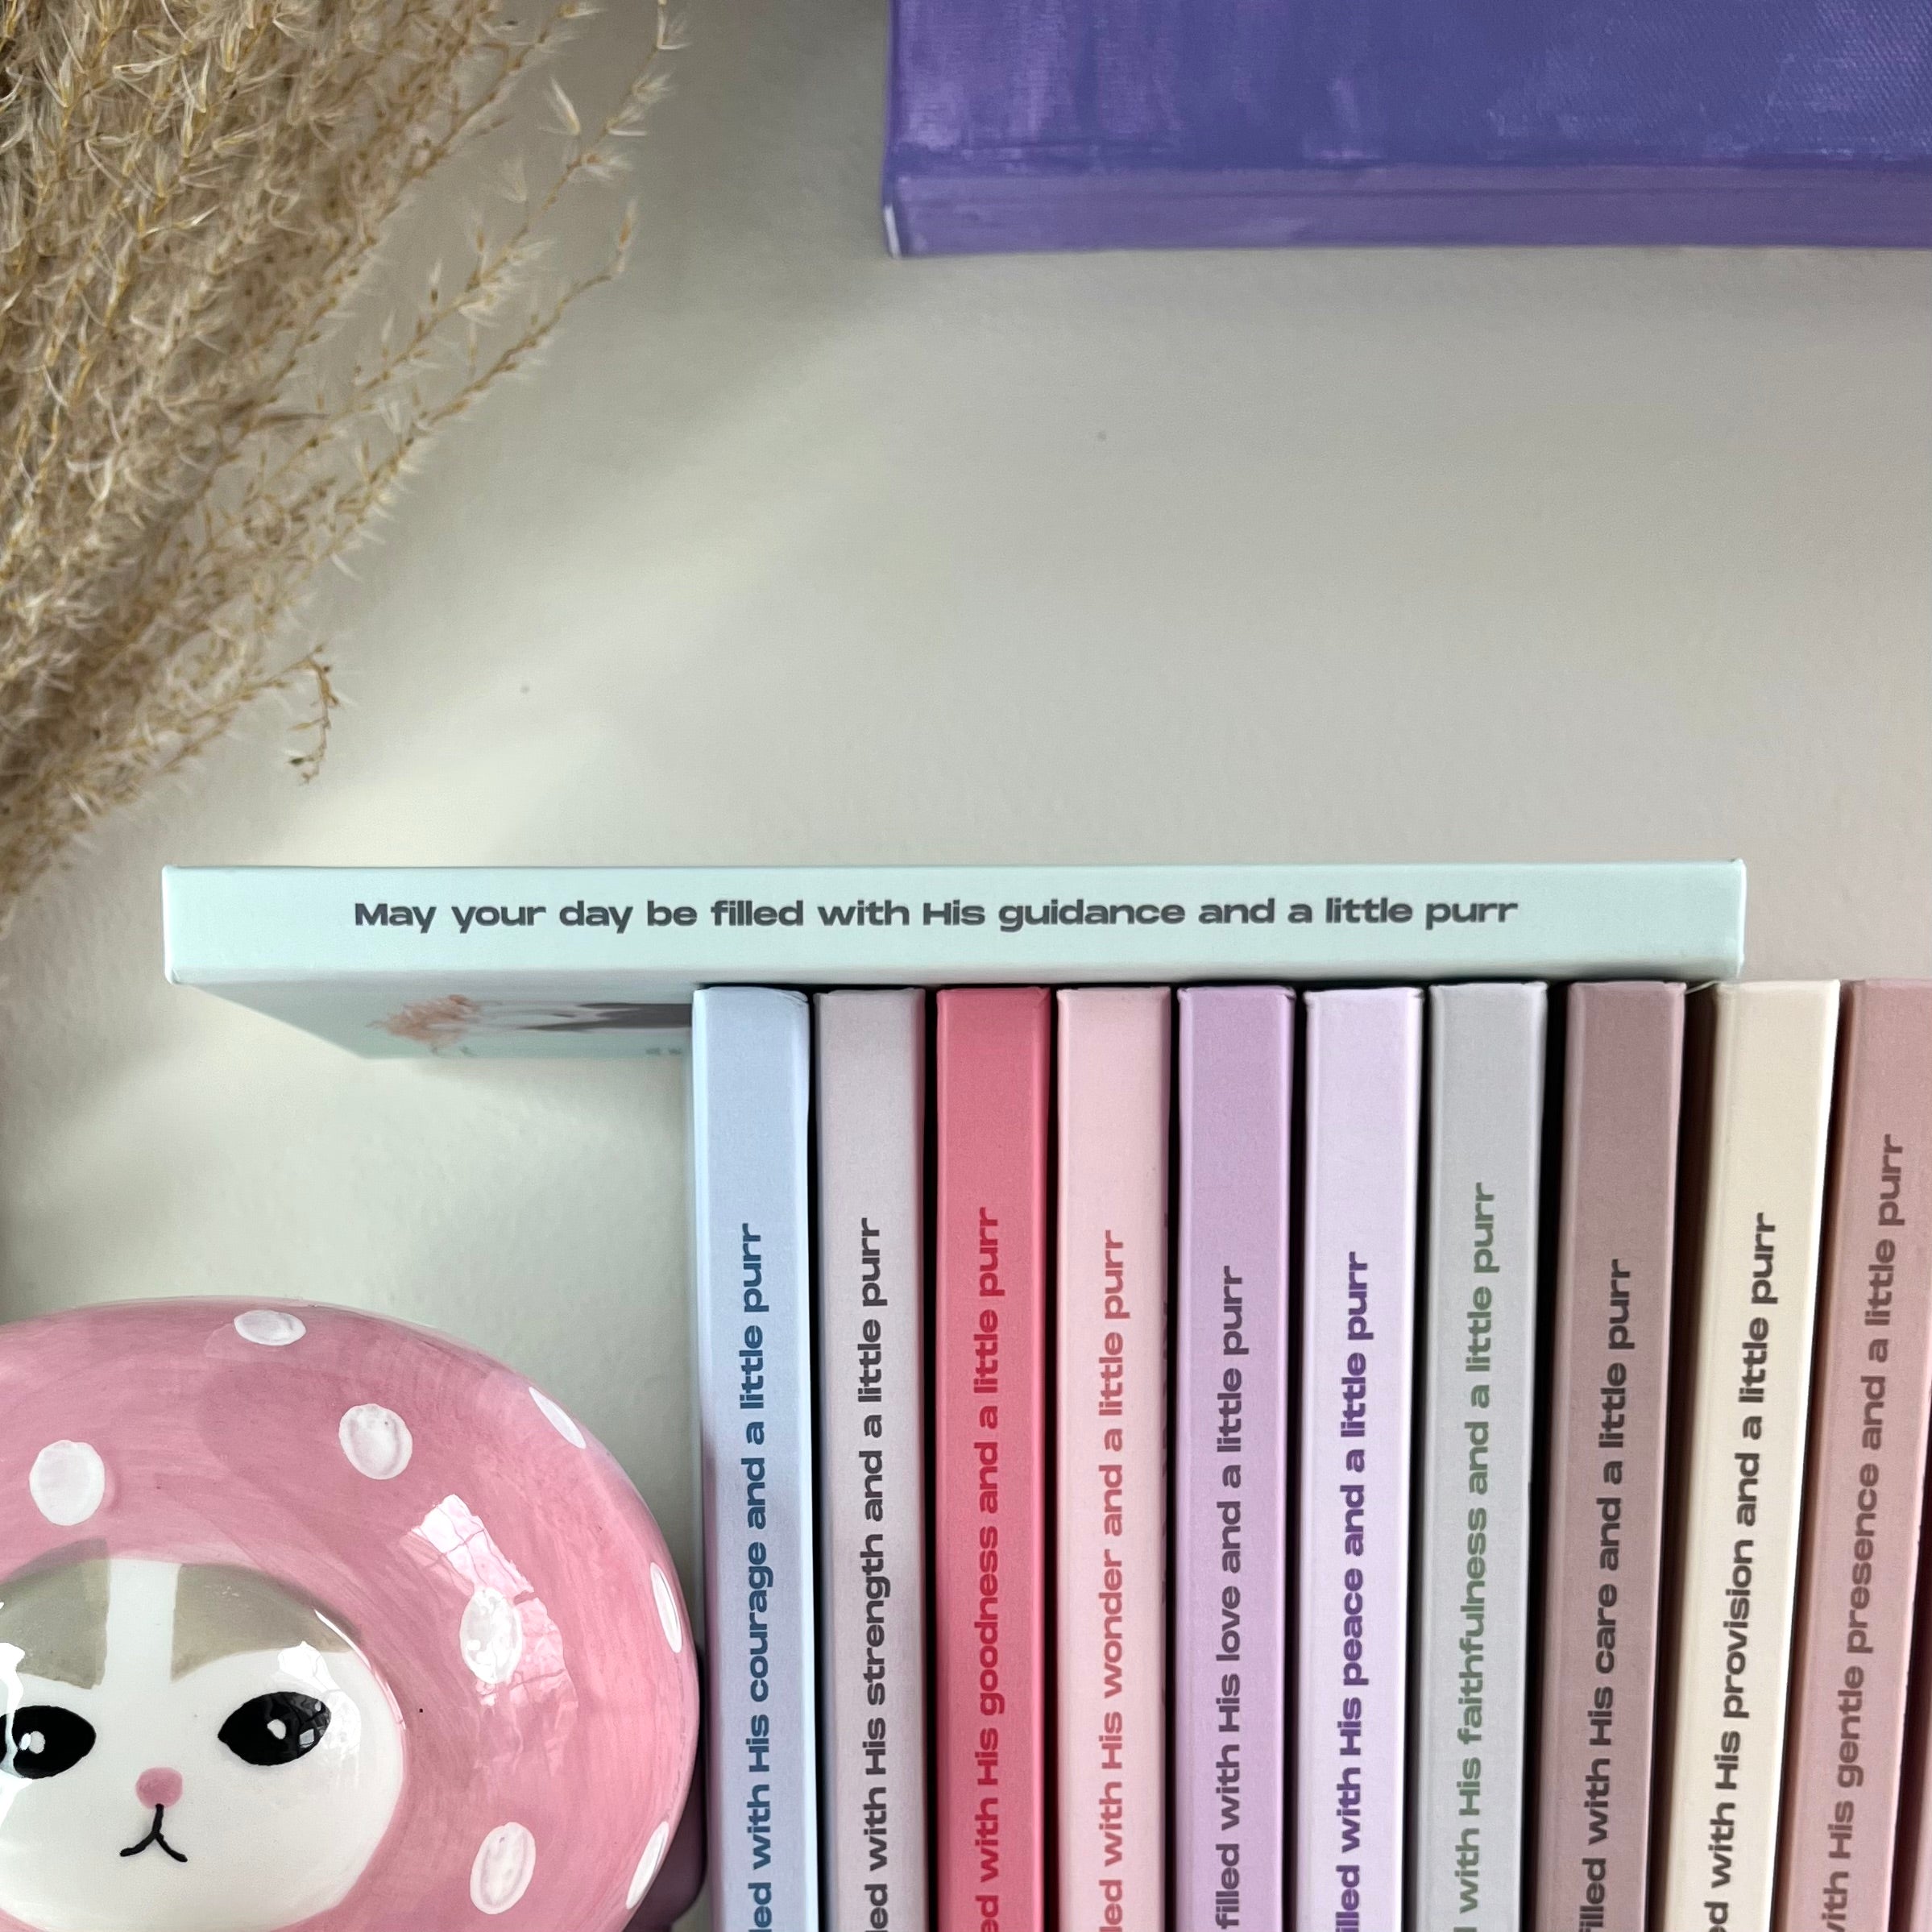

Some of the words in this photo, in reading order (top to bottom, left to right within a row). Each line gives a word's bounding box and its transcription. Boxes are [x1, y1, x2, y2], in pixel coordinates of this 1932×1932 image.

[354, 902, 437, 934] May
[451, 906, 546, 934] your
[559, 900, 633, 934] day
[647, 900, 698, 927] be
[711, 899, 804, 927] filled
[817, 899, 910, 926] with
[922, 899, 985, 926] His
[998, 898, 1186, 933] guidance
[1198, 897, 1275, 924] and
[1287, 903, 1313, 923] a
[1325, 897, 1413, 923] little
[1425, 902, 1519, 931] purr
[1878, 1134, 1905, 1226] purr
[742, 1223, 769, 1312] purr
[861, 1217, 888, 1307] purr
[979, 1207, 1005, 1296] purr
[1474, 1182, 1500, 1273] purr
[1751, 1212, 1779, 1304] purr
[1105, 1229, 1130, 1319] purr
[1223, 1266, 1250, 1355] purr
[1347, 1251, 1374, 1341] purr
[1608, 1258, 1636, 1349] purr
[1864, 1239, 1896, 1325] little
[739, 1325, 764, 1409] little
[857, 1319, 881, 1403] little
[973, 1309, 998, 1393] little
[1466, 1287, 1492, 1372] little
[1738, 1317, 1769, 1403] little
[1868, 1339, 1889, 1362] a
[1099, 1332, 1123, 1416] little
[1217, 1368, 1242, 1453] little
[1341, 1352, 1366, 1437] little
[1470, 1385, 1490, 1408] a
[1598, 1362, 1627, 1448] little
[1860, 1375, 1886, 1450] and
[746, 1421, 765, 1445] a
[864, 1415, 882, 1438] a
[980, 1406, 997, 1429] a
[1104, 1428, 1122, 1452] a
[1464, 1421, 1489, 1495] and
[1742, 1416, 1763, 1441] a
[740, 1457, 766, 1529] and
[858, 1450, 883, 1522] and
[974, 1442, 998, 1514] and
[1098, 1465, 1122, 1536] and
[1222, 1465, 1242, 1488] a
[1345, 1449, 1365, 1473] a
[1603, 1461, 1623, 1485] a
[1734, 1453, 1760, 1527] and
[1217, 1501, 1241, 1573] and
[1339, 1484, 1365, 1557] and
[1596, 1498, 1622, 1571] and
[1847, 1463, 1879, 1654] presence
[748, 1542, 773, 1702] courage
[860, 1534, 891, 1706] strength
[974, 1526, 1005, 1715] goodness
[1098, 1549, 1122, 1698] wonder
[1216, 1586, 1241, 1661] love
[1343, 1568, 1370, 1686] peace
[1457, 1507, 1487, 1745] faithfulness
[1595, 1584, 1618, 1674] care
[1723, 1539, 1754, 1718] provision
[745, 1714, 769, 1772] His
[1099, 1711, 1122, 1769] His
[1216, 1673, 1240, 1732] His
[1337, 1697, 1362, 1756] His
[1587, 1686, 1614, 1746] His
[1837, 1666, 1864, 1788] gentle
[862, 1718, 886, 1776] His
[975, 1728, 998, 1785] His
[1216, 1744, 1240, 1831] with
[1457, 1757, 1482, 1816] His
[1714, 1731, 1741, 1790] His
[747, 1784, 771, 1870] with
[863, 1787, 887, 1872] with
[975, 1797, 998, 1883] with
[1099, 1781, 1122, 1867] with
[1336, 1767, 1361, 1853] with
[1584, 1758, 1611, 1845] with
[1827, 1801, 1854, 1859] His
[1215, 1843, 1240, 1930] filled
[1454, 1828, 1480, 1913] with
[1708, 1802, 1736, 1888] with
